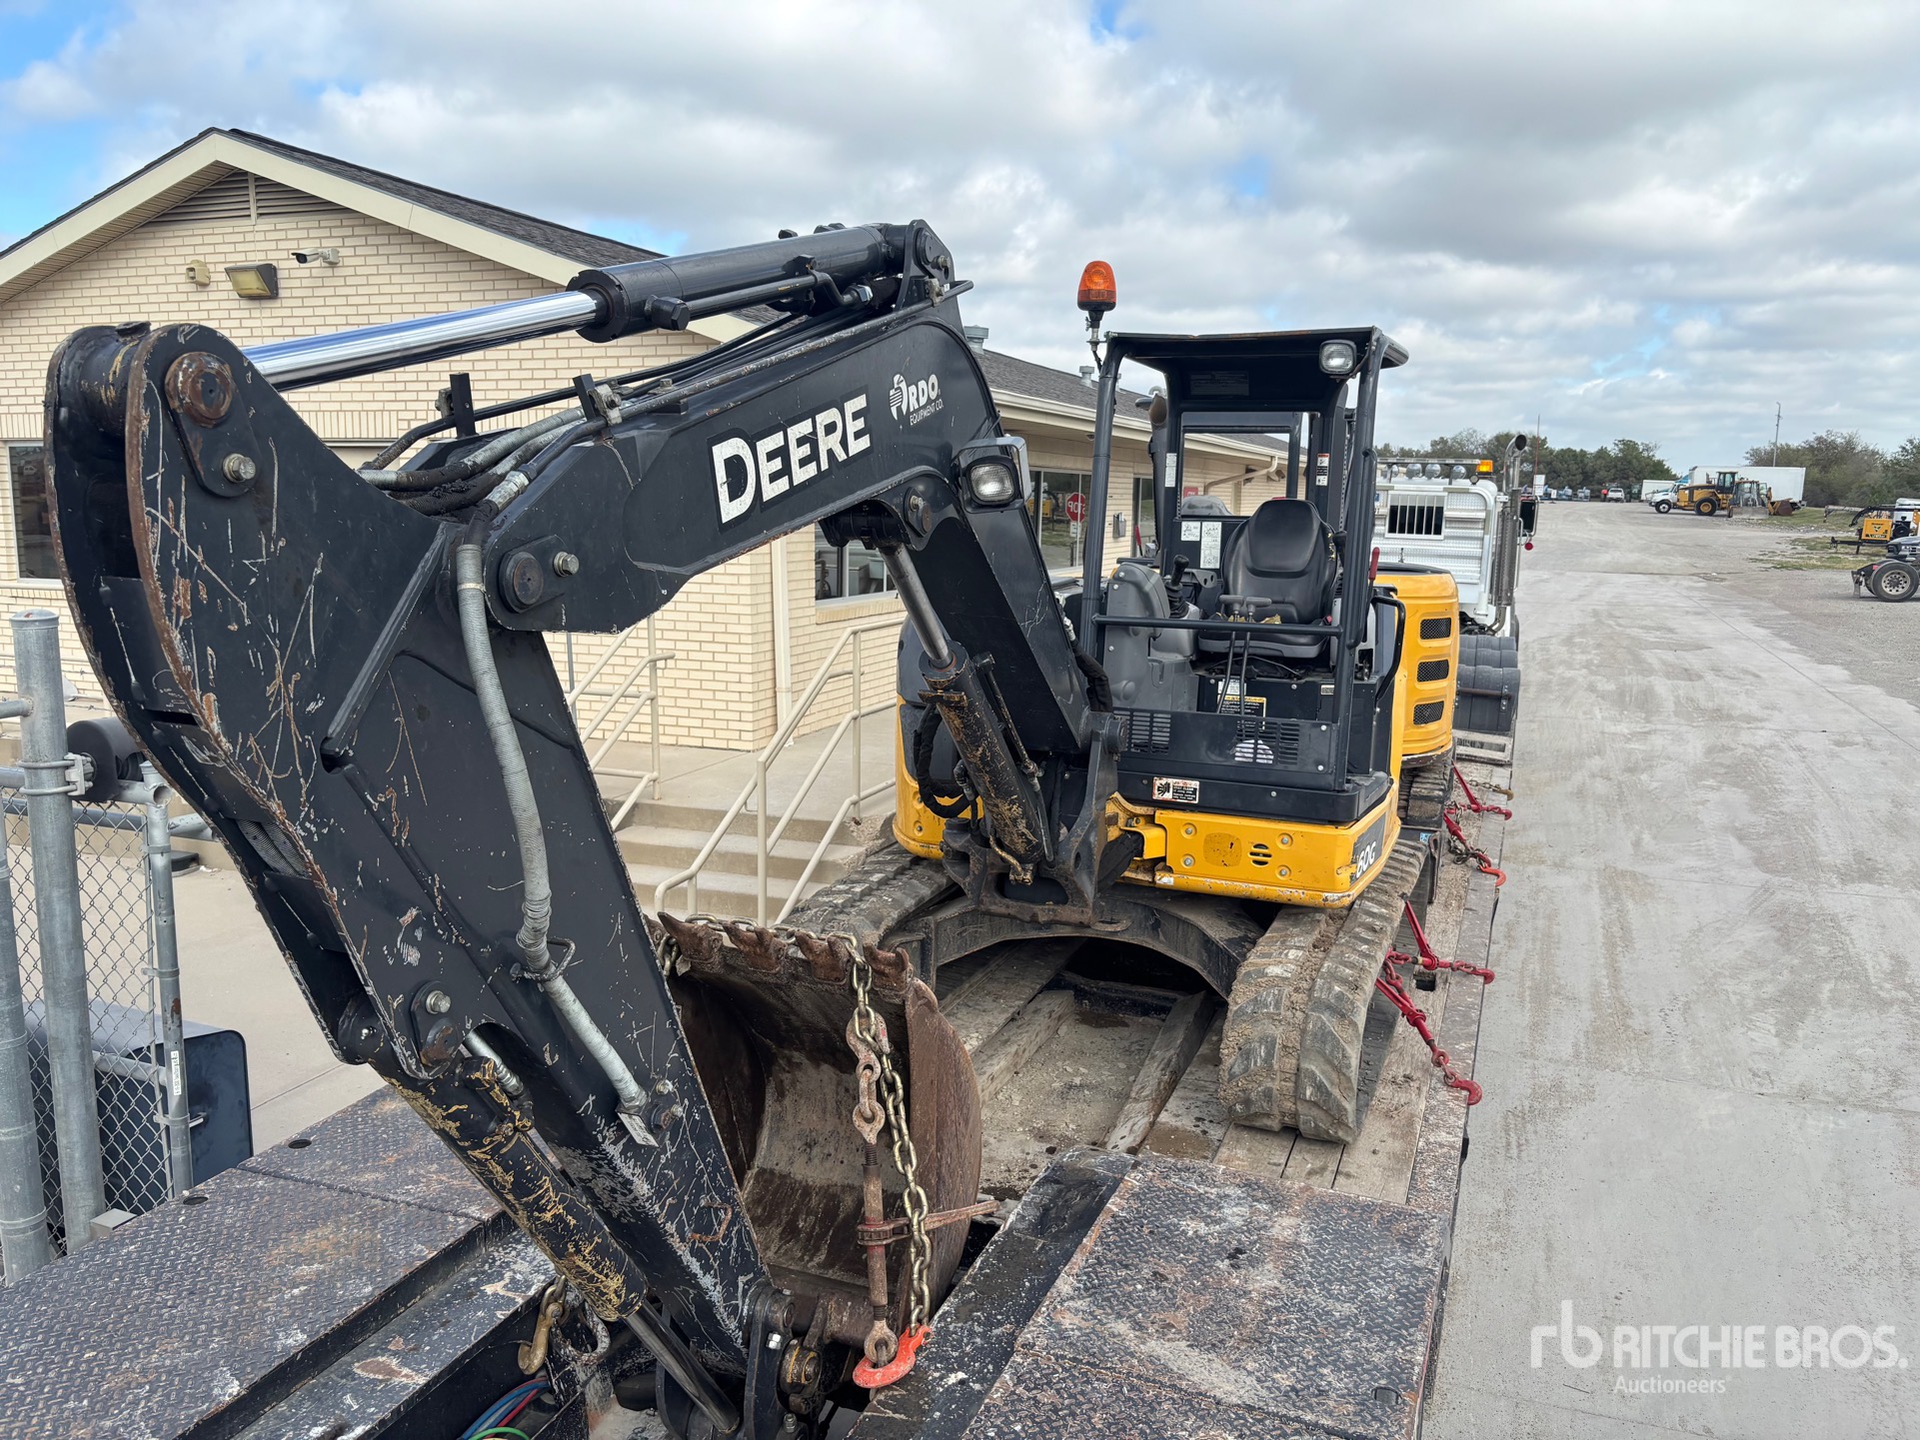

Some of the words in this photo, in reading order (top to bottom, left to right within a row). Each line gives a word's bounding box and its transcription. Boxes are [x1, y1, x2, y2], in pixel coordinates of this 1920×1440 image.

[908, 374, 938, 412] RDO
[712, 394, 870, 524] DEERE
[1356, 841, 1377, 879] 60G
